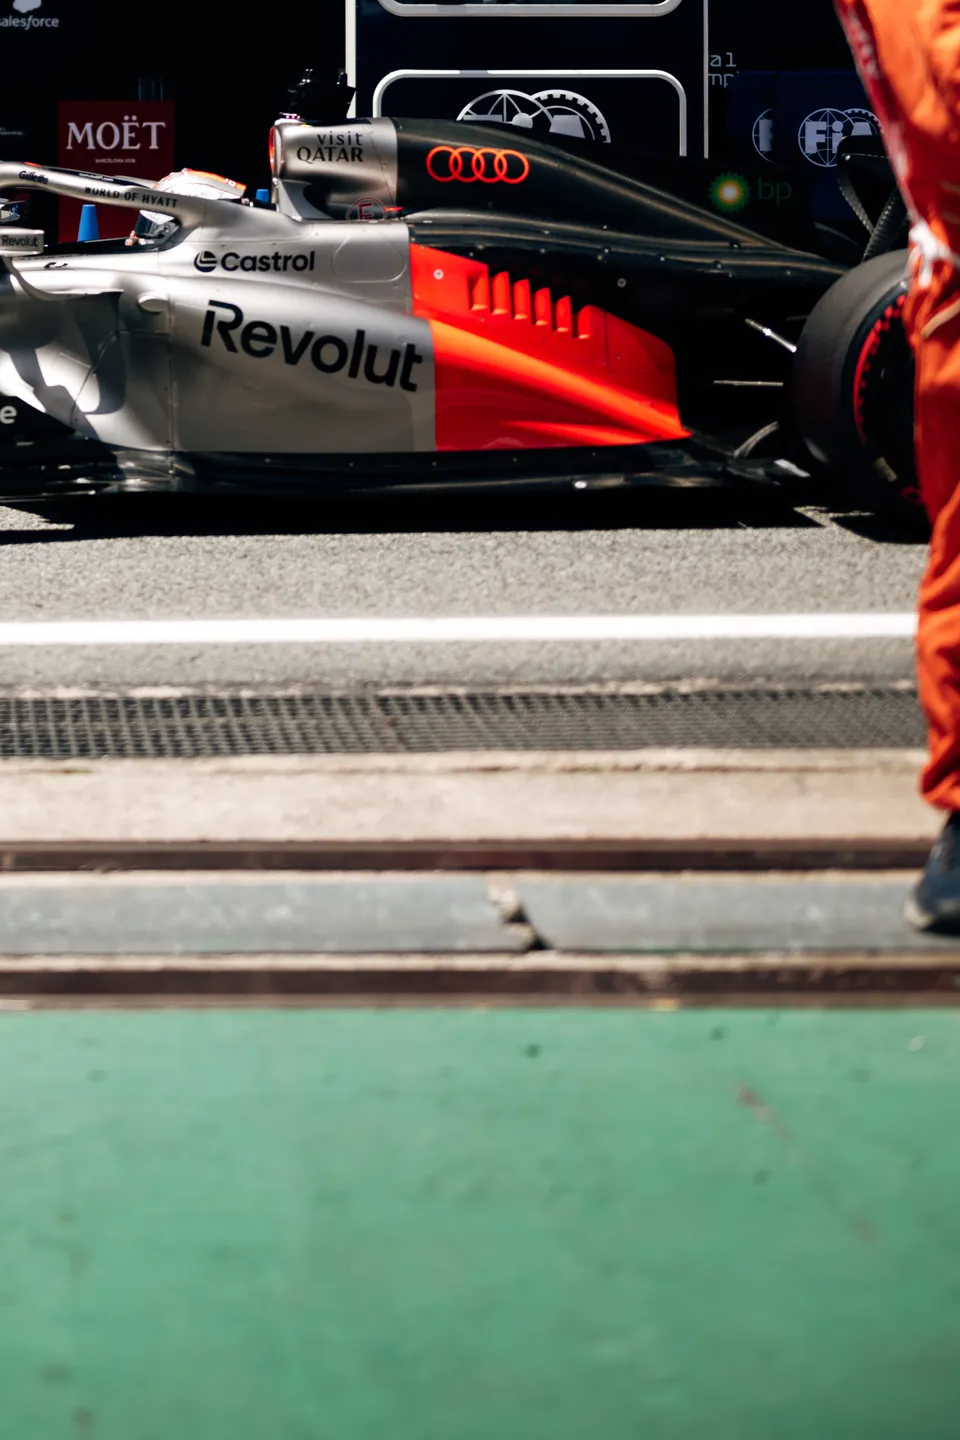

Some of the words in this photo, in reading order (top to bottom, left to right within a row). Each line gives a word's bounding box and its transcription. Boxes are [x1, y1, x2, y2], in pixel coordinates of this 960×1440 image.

[66, 115, 166, 151] MOËT
[317, 131, 364, 148] visit
[297, 146, 364, 164] QATAR
[19, 170, 49, 186] Gillette
[85, 186, 120, 200] WORLD
[124, 191, 138, 202] OF
[142, 194, 178, 208] HYATT
[757, 177, 792, 206] bp
[1, 235, 38, 247] Revolut
[220, 250, 316, 272] Castrol
[201, 299, 424, 393] Revolut
